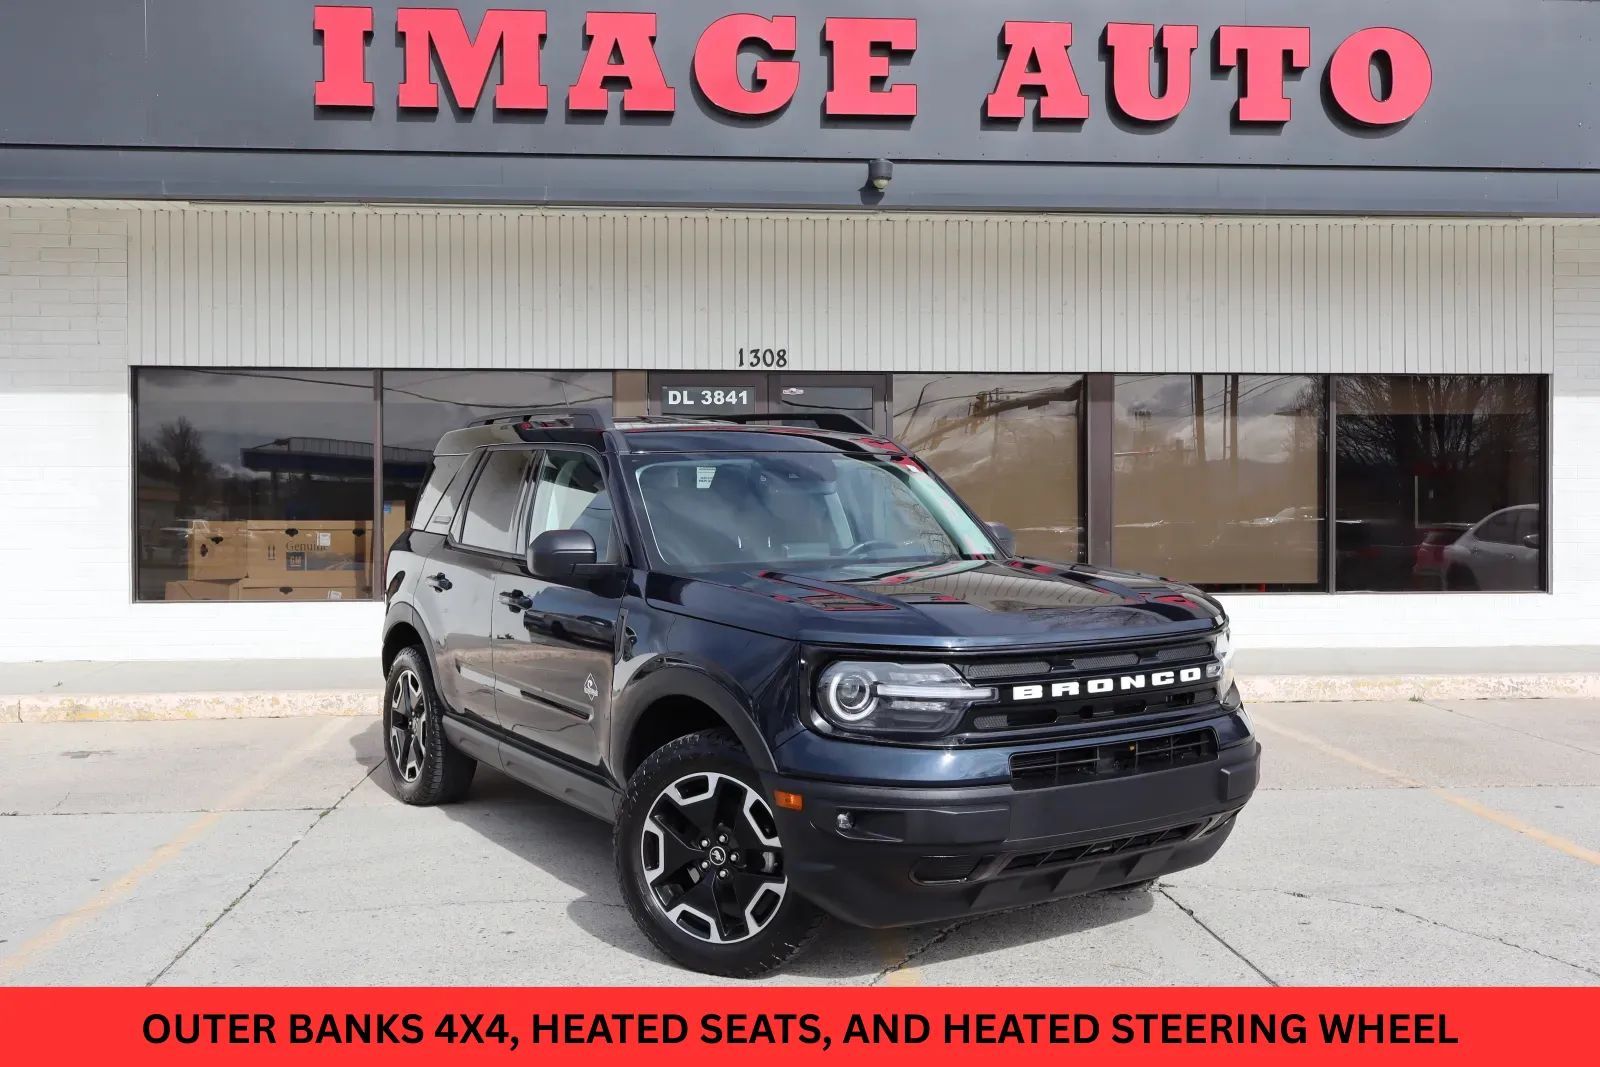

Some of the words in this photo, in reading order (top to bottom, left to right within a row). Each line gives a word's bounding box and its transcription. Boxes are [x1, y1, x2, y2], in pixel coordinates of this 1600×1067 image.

[312, 5, 918, 116] IMAGE
[986, 20, 1433, 125] AUTO
[738, 348, 788, 367] 1308
[668, 390, 695, 405] DL
[701, 390, 747, 405] 3841
[1012, 667, 1201, 701] BRONCO
